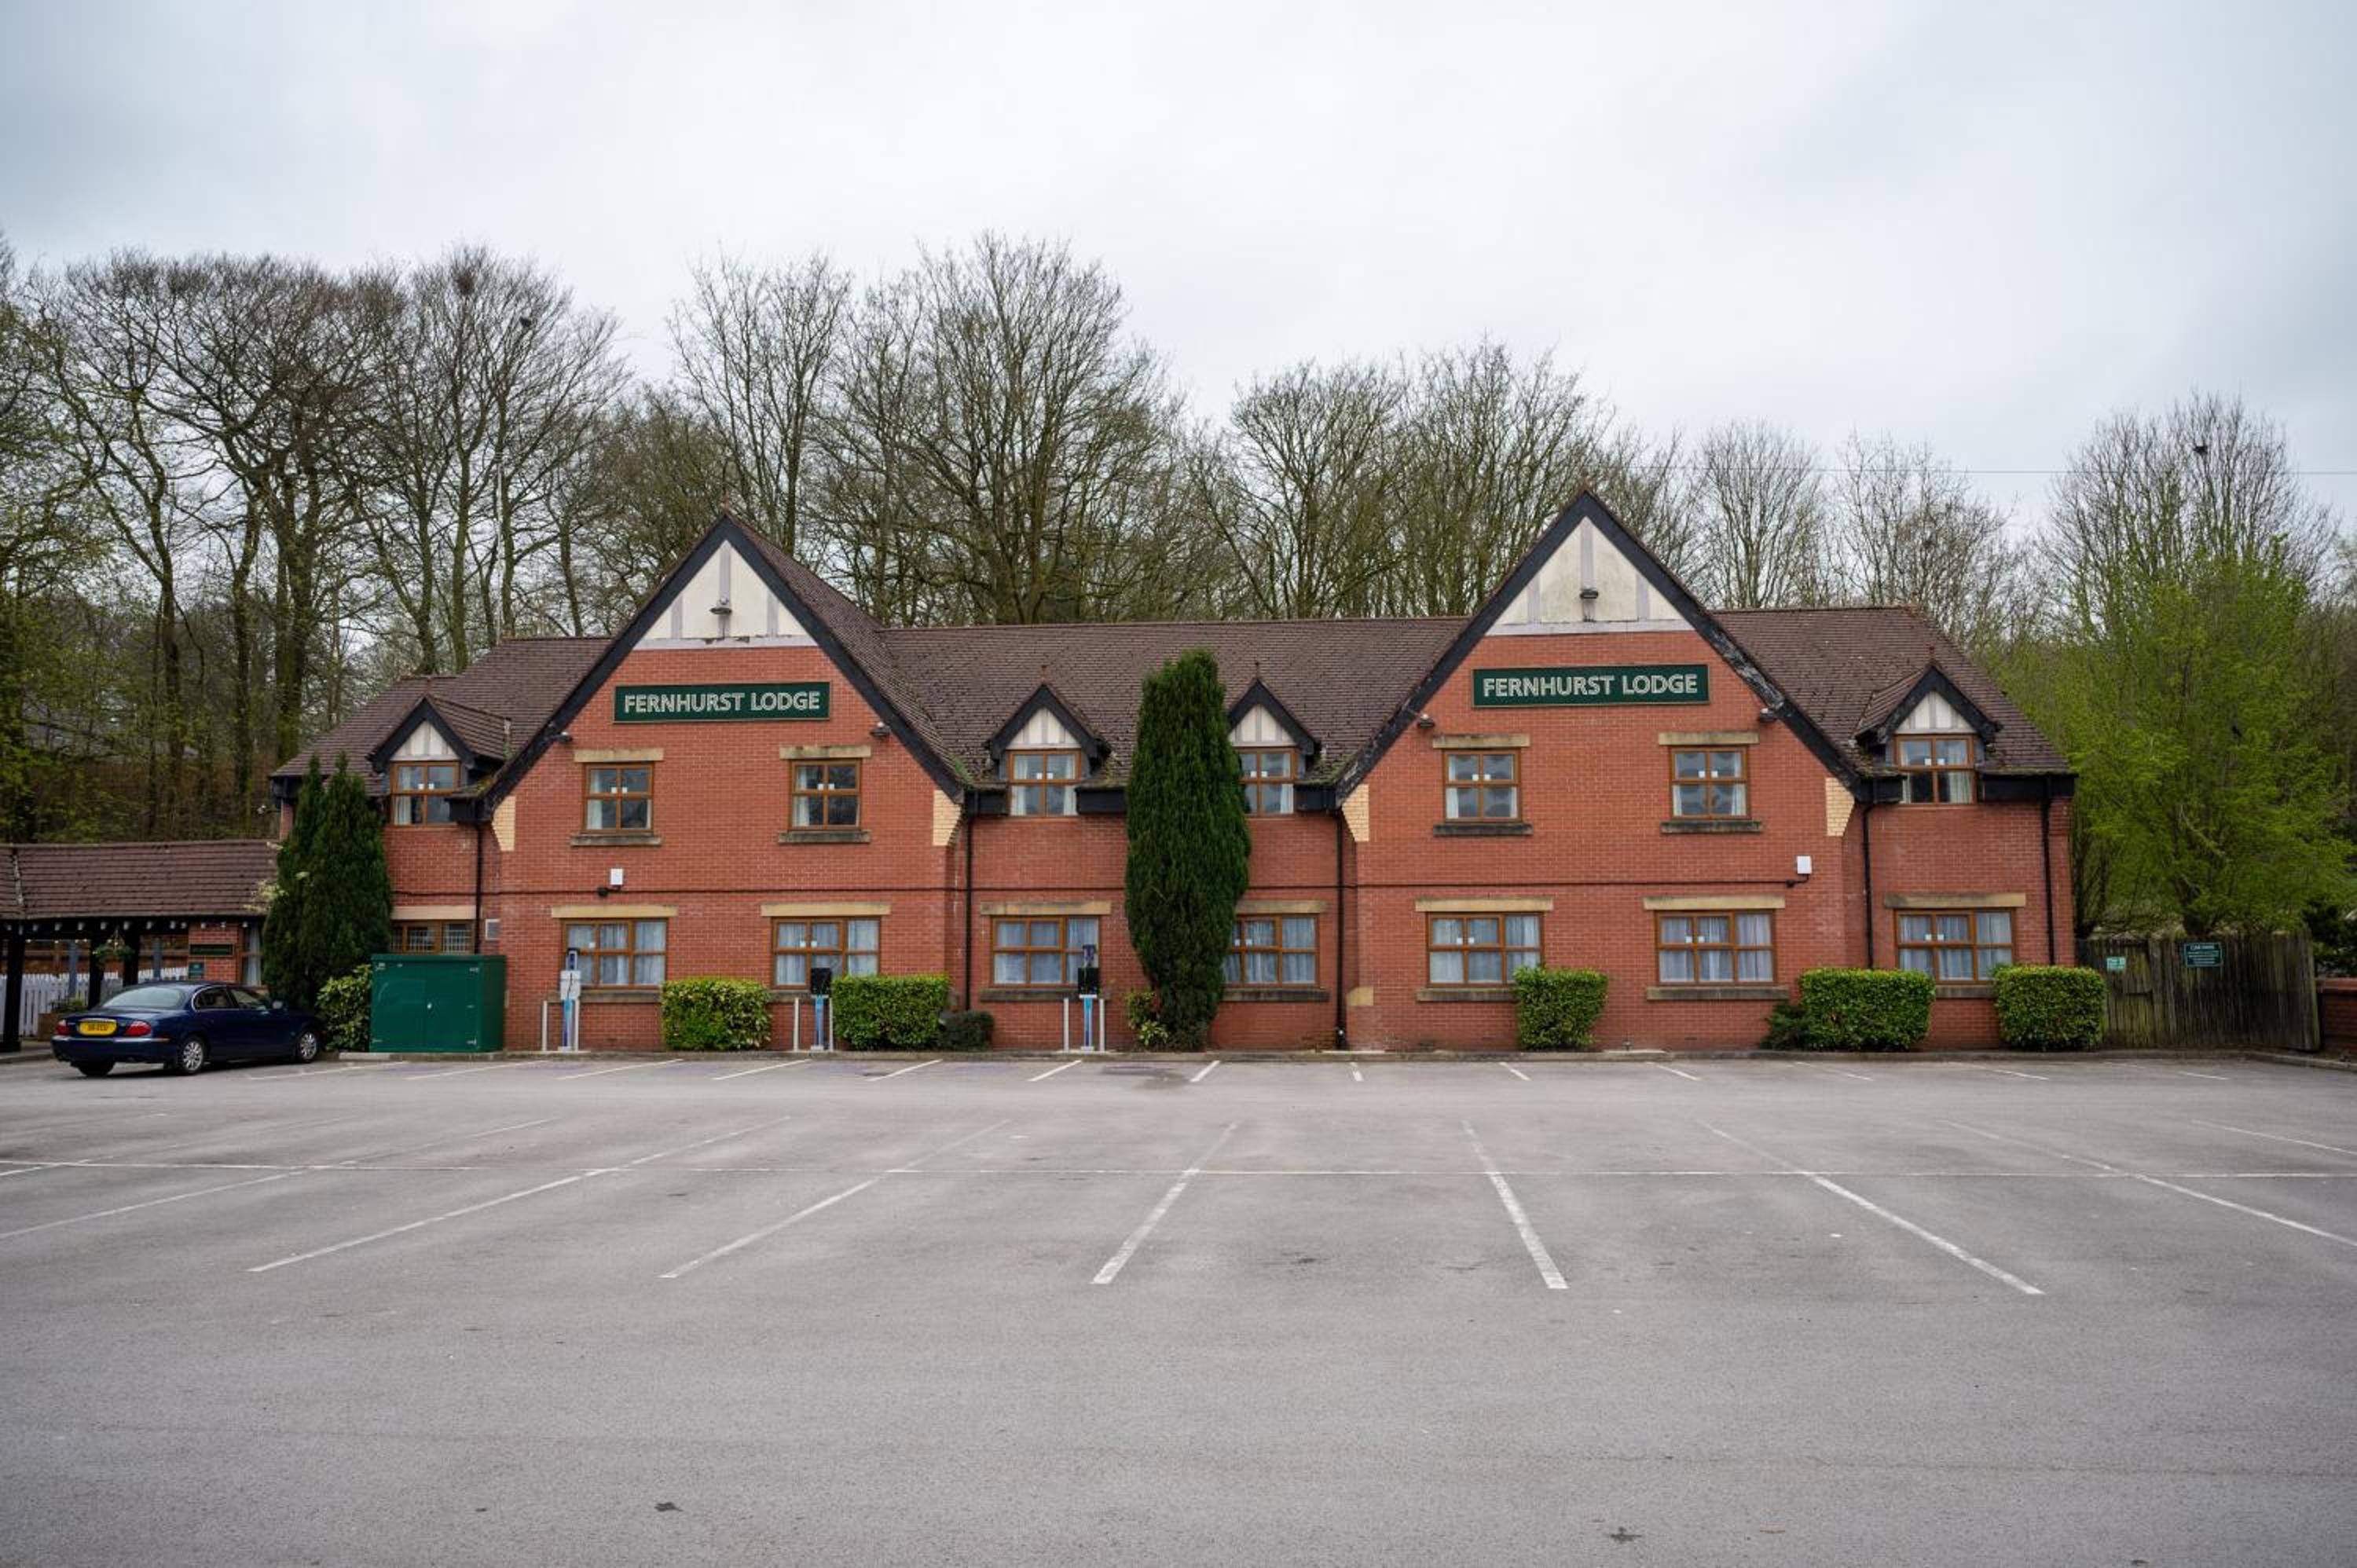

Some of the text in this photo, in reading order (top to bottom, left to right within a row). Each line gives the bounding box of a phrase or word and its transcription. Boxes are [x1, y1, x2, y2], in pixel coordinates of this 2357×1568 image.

[1483, 674, 1697, 697] FERNHURST LODGE
[625, 691, 820, 713] FERNHURST LODGE
